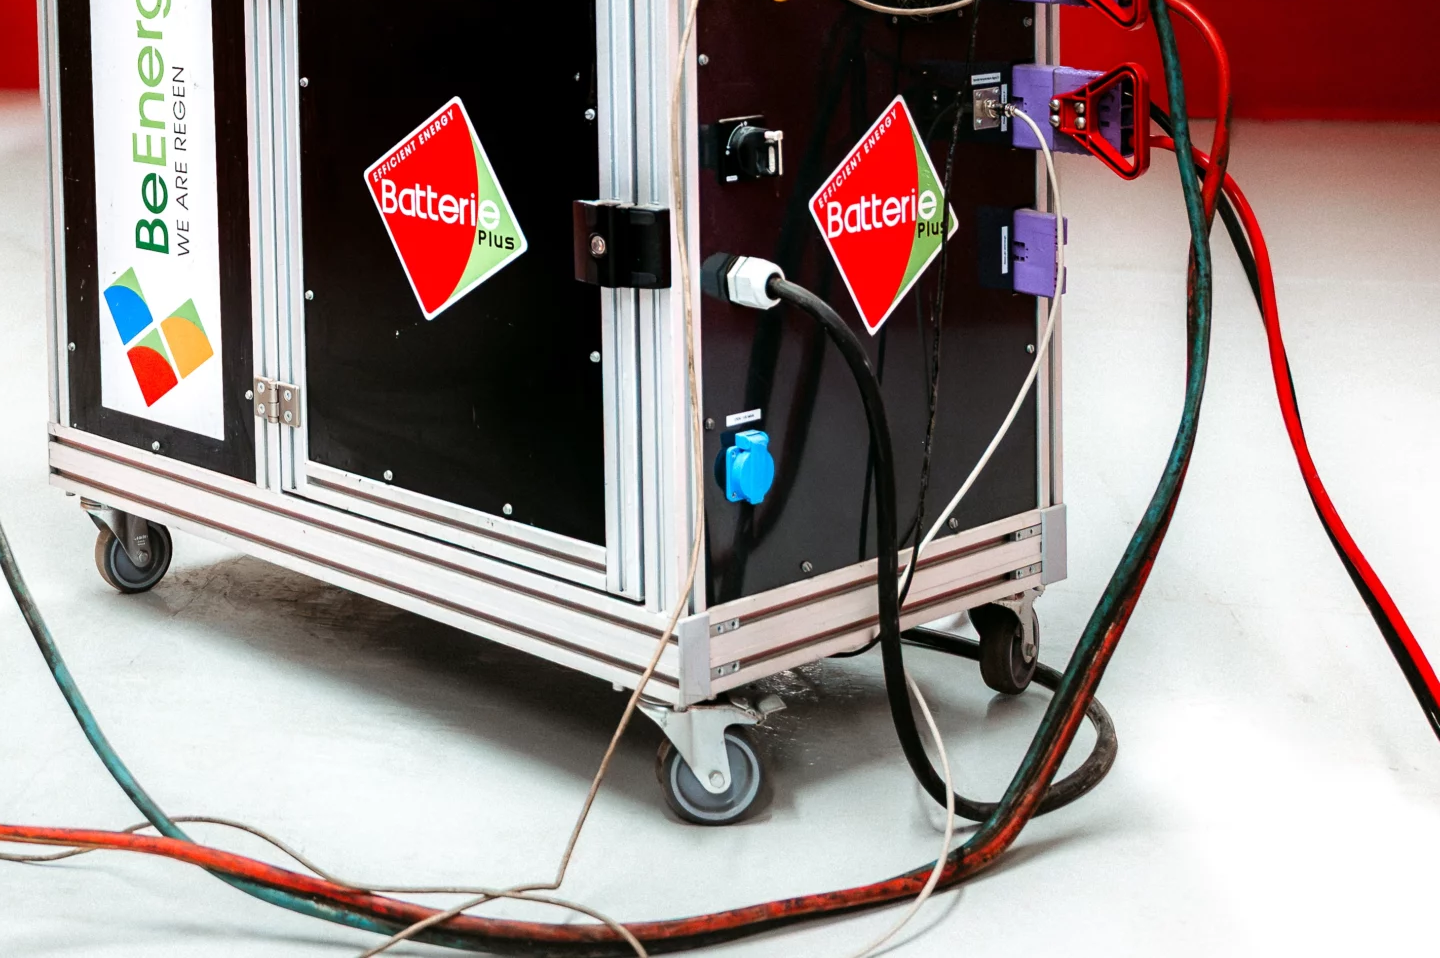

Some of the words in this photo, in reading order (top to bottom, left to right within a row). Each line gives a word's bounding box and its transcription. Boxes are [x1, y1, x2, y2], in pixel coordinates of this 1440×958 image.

[172, 66, 187, 151] REGEN
[372, 140, 417, 183] EFFICIENT
[418, 108, 455, 146] ENERGY
[817, 153, 862, 209] EFFICIENT
[863, 108, 897, 155] ENERGY
[174, 161, 188, 211] ARE
[381, 178, 501, 230] Batterie
[177, 218, 190, 256] WE
[826, 188, 937, 239] Batterie
[478, 229, 515, 251] Plus
